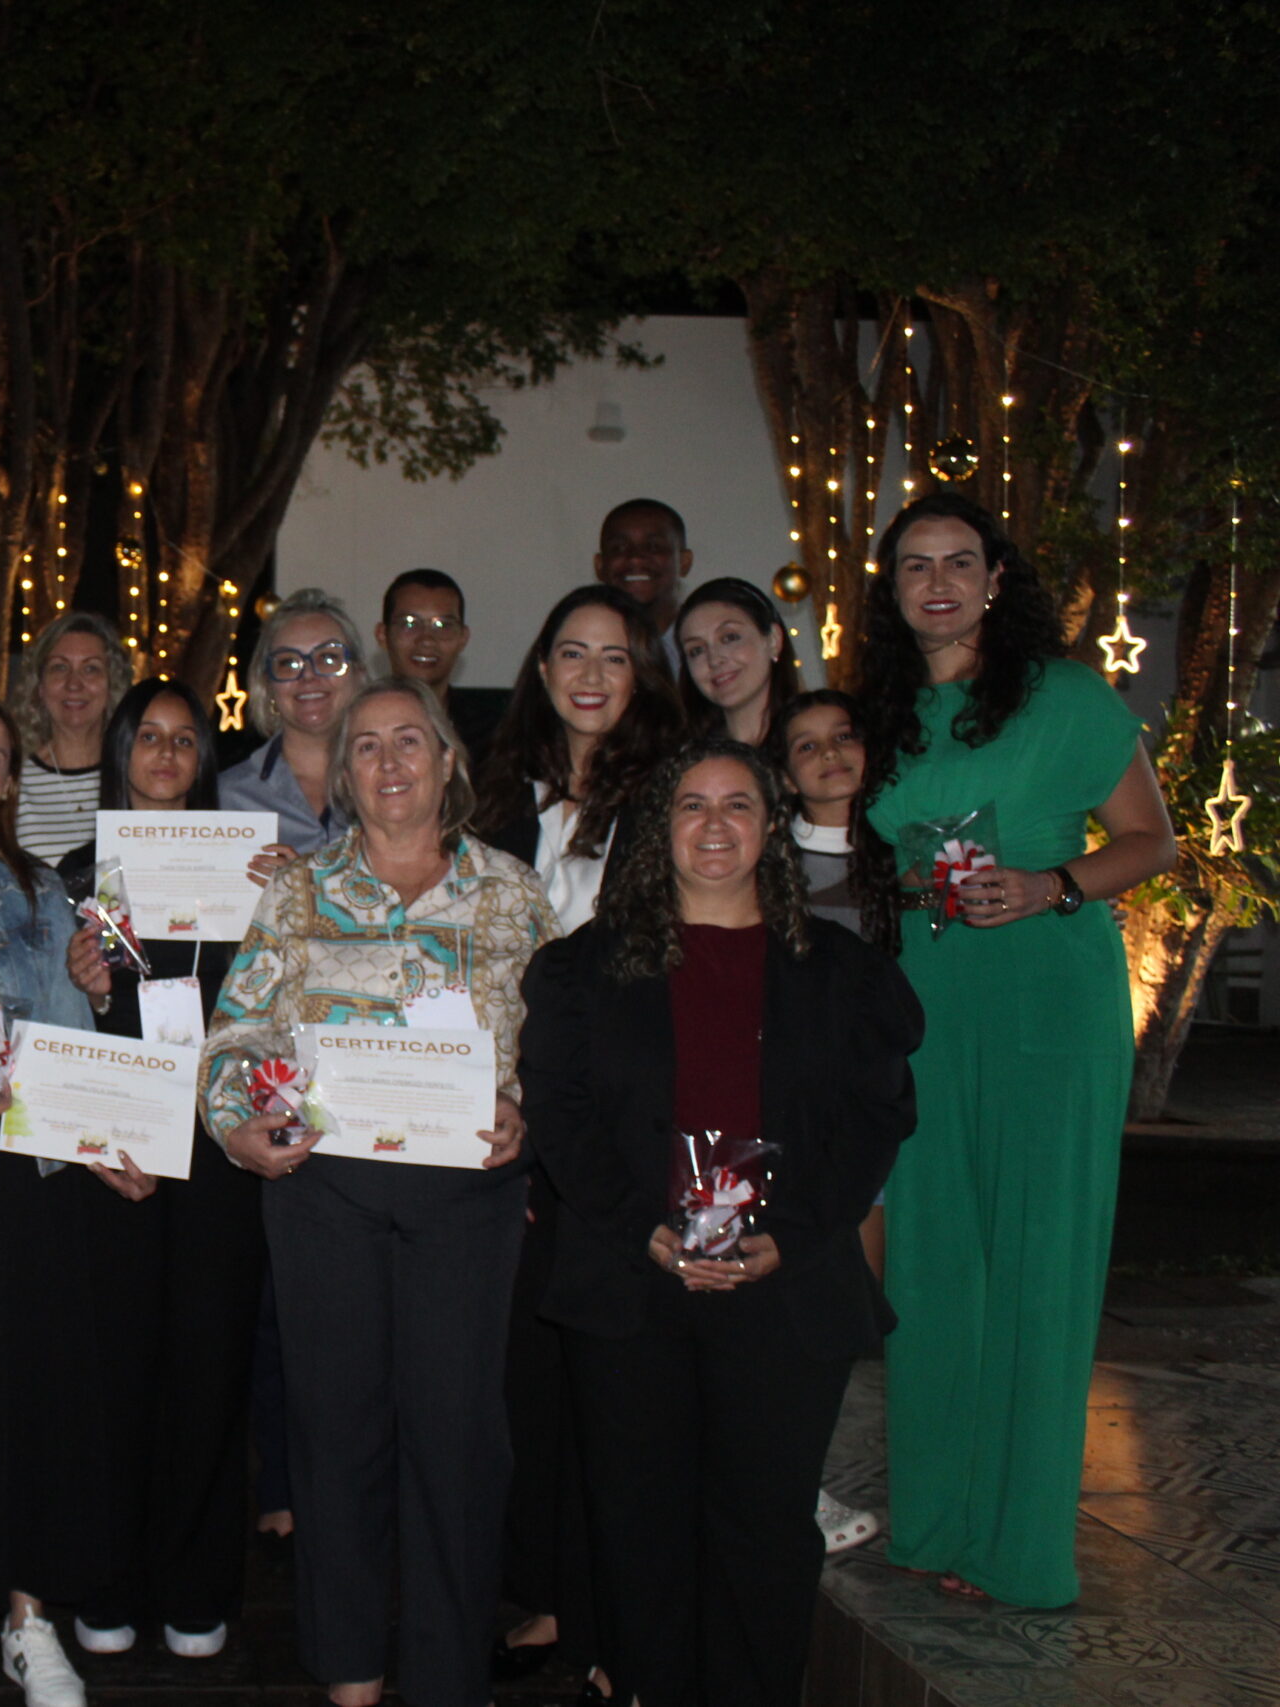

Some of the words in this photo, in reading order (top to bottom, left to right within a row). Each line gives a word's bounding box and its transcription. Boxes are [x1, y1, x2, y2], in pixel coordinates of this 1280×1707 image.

[118, 826, 256, 839] CERTIFICADO
[33, 1039, 177, 1072] CERTIFICADO
[319, 1036, 472, 1056] CERTIFICADO
